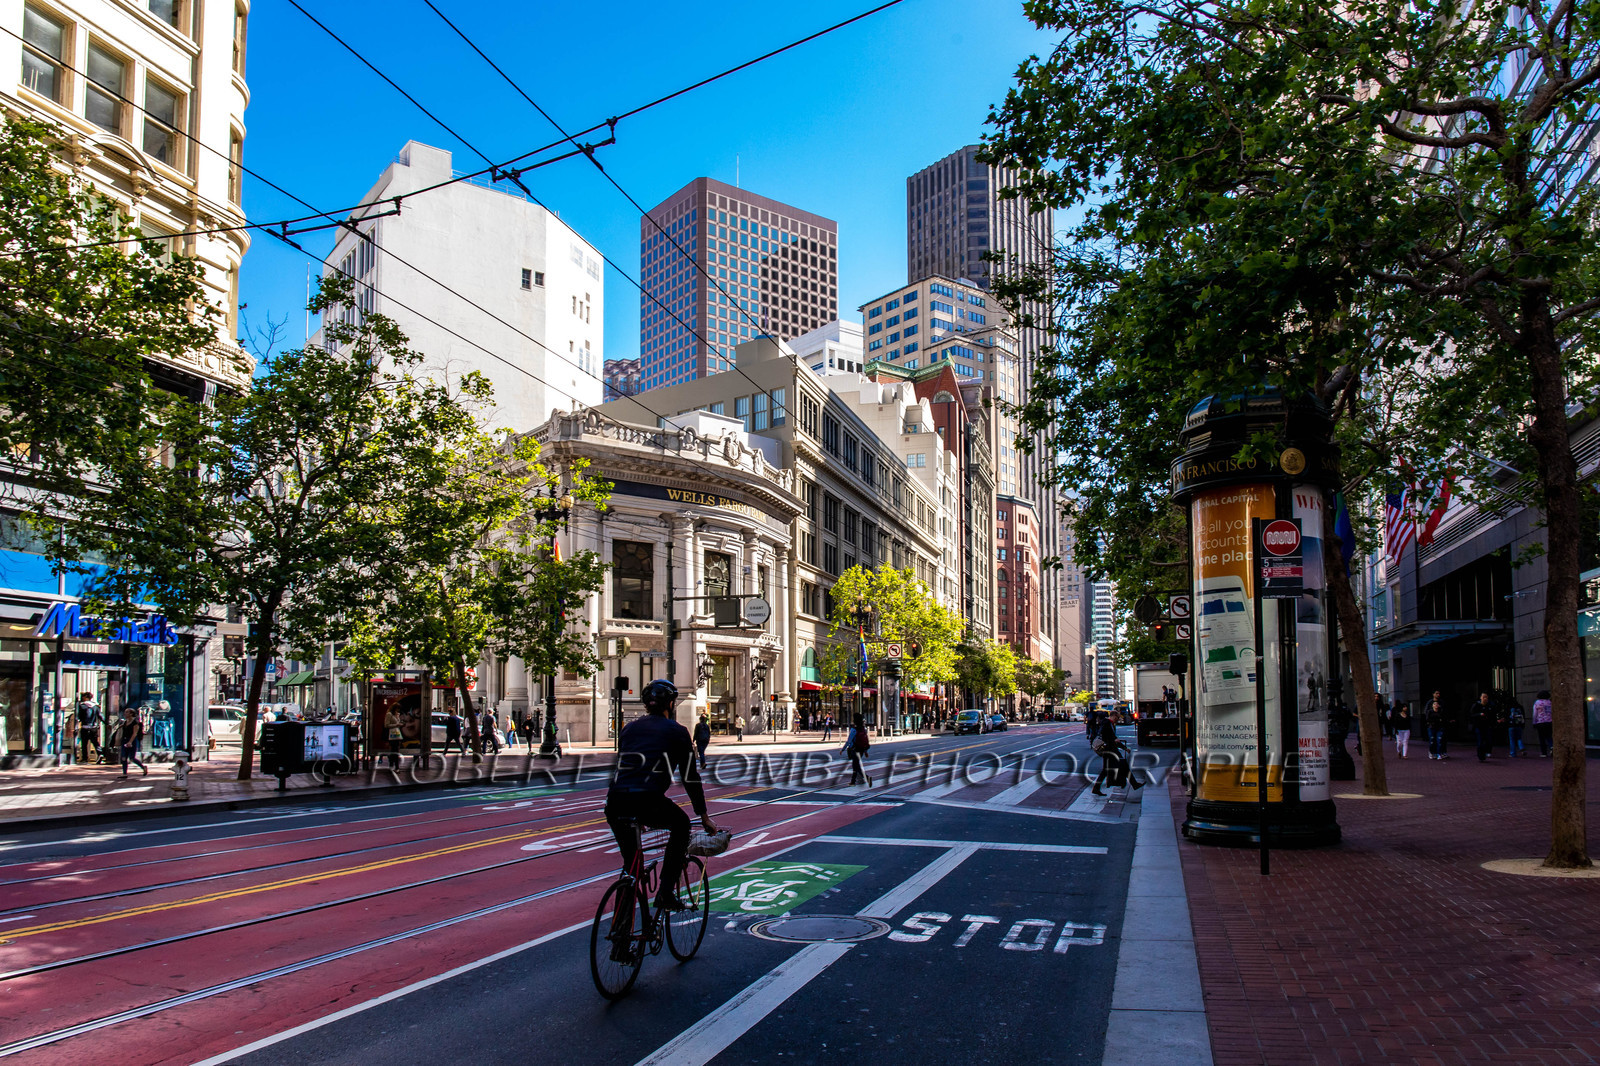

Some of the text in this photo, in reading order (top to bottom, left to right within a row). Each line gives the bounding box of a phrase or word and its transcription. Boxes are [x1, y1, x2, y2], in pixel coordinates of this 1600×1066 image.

[1187, 457, 1257, 481] FRANCISCO
[666, 488, 767, 524] WELLS FARGO BANK
[1221, 494, 1260, 505] CAPITAL
[1209, 520, 1220, 533] all
[1225, 519, 1252, 534] you
[1222, 549, 1254, 566] plac
[1264, 558, 1270, 568] 5
[1264, 578, 1271, 588] 7
[33, 601, 179, 646] Mashalls
[1299, 737, 1311, 748] MAY
[888, 911, 1108, 954] STOP
